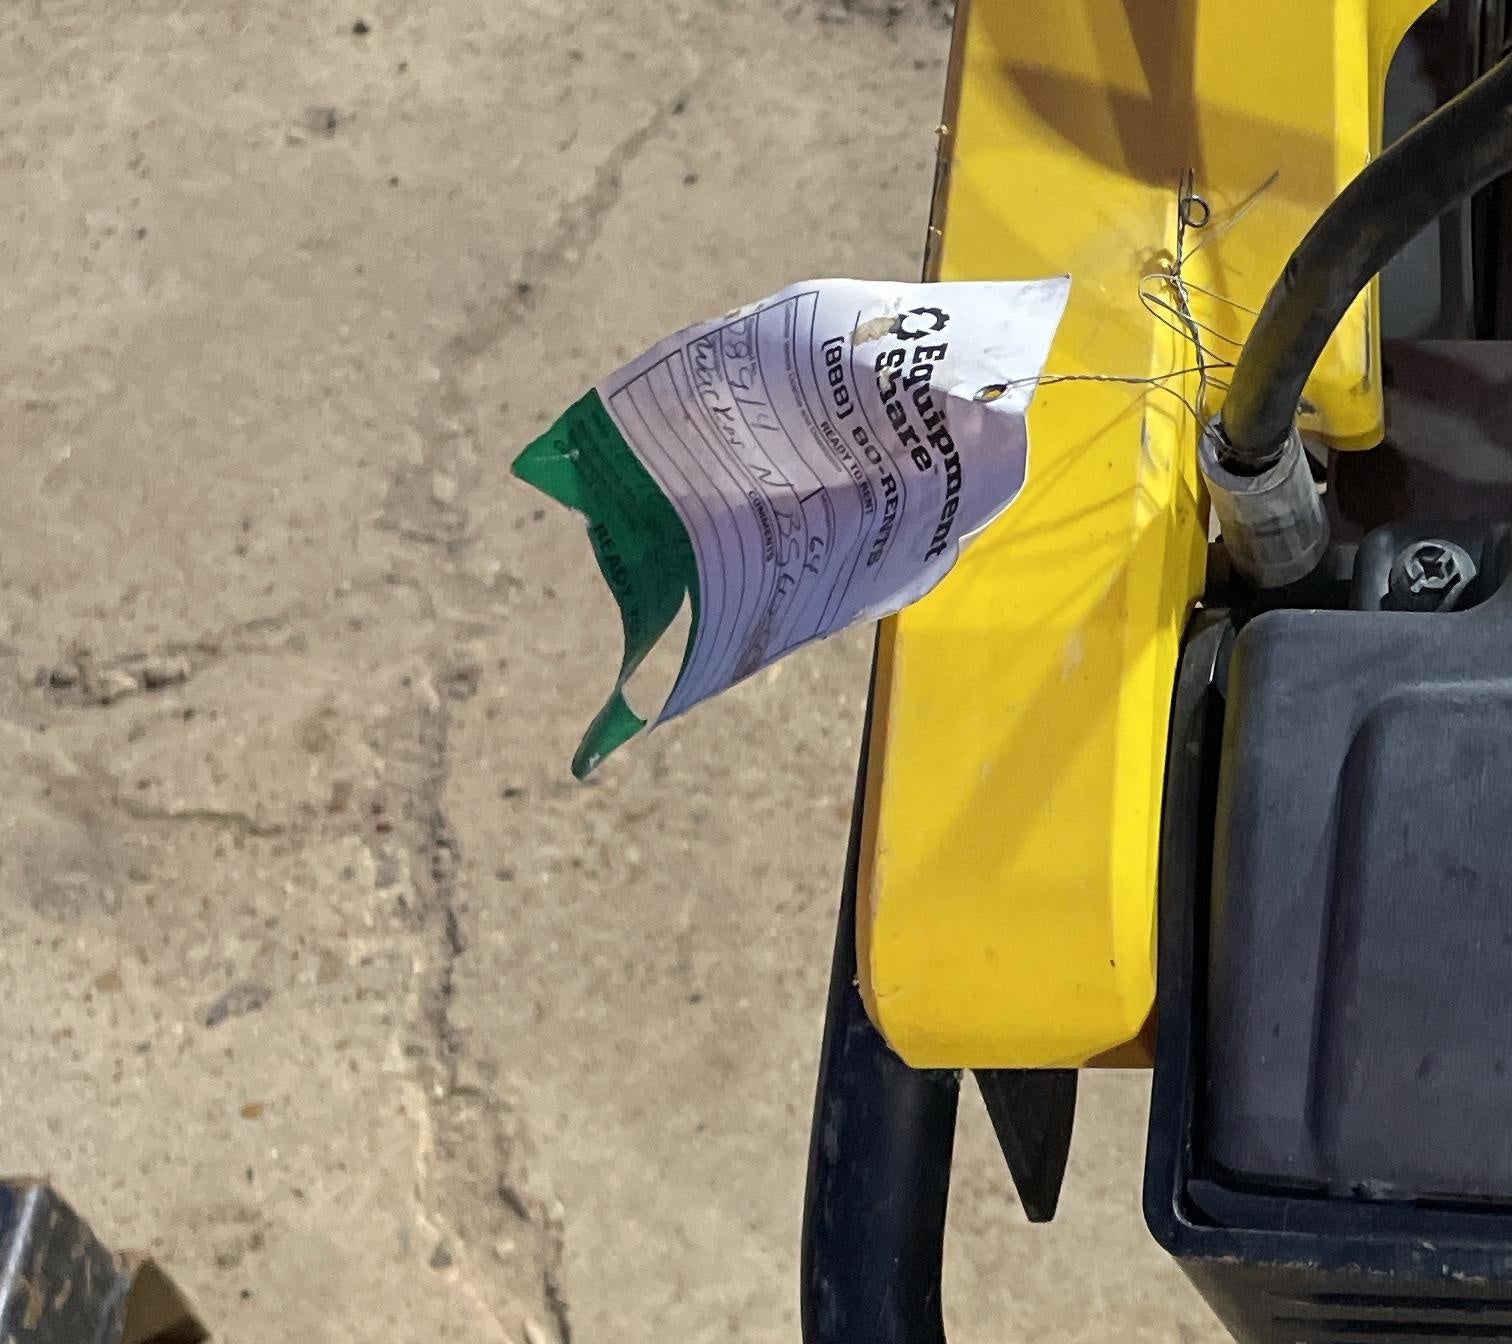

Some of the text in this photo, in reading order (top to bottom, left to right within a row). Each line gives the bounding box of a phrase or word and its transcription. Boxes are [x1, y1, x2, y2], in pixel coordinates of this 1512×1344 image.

[820, 336, 898, 567] (888) 80-RENTS
[820, 421, 874, 514] READY TO RENT
[875, 347, 932, 472] Share
[903, 342, 961, 562] Equipment
[748, 489, 774, 563] COMMENTS
